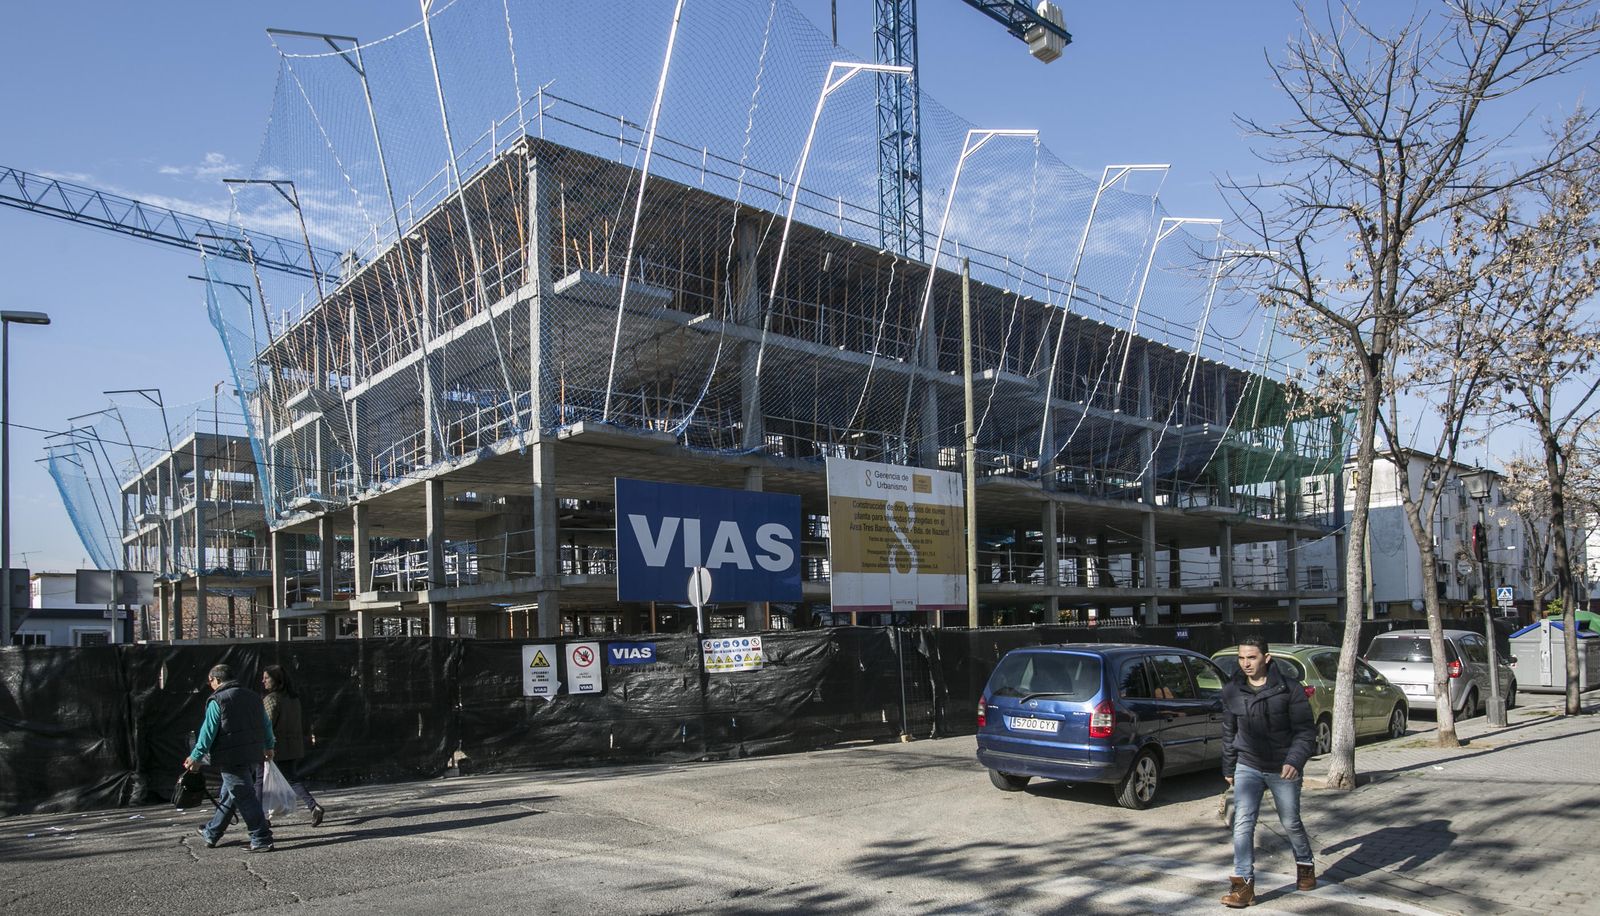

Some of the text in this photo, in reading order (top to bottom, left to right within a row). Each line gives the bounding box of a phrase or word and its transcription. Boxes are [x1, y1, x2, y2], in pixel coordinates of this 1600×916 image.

[874, 470, 909, 482] Gerencia de
[877, 481, 907, 491] Urbanismo
[628, 514, 794, 573] VIAS
[612, 647, 652, 659] VIAS
[1016, 718, 1057, 731] 5700 CYX
